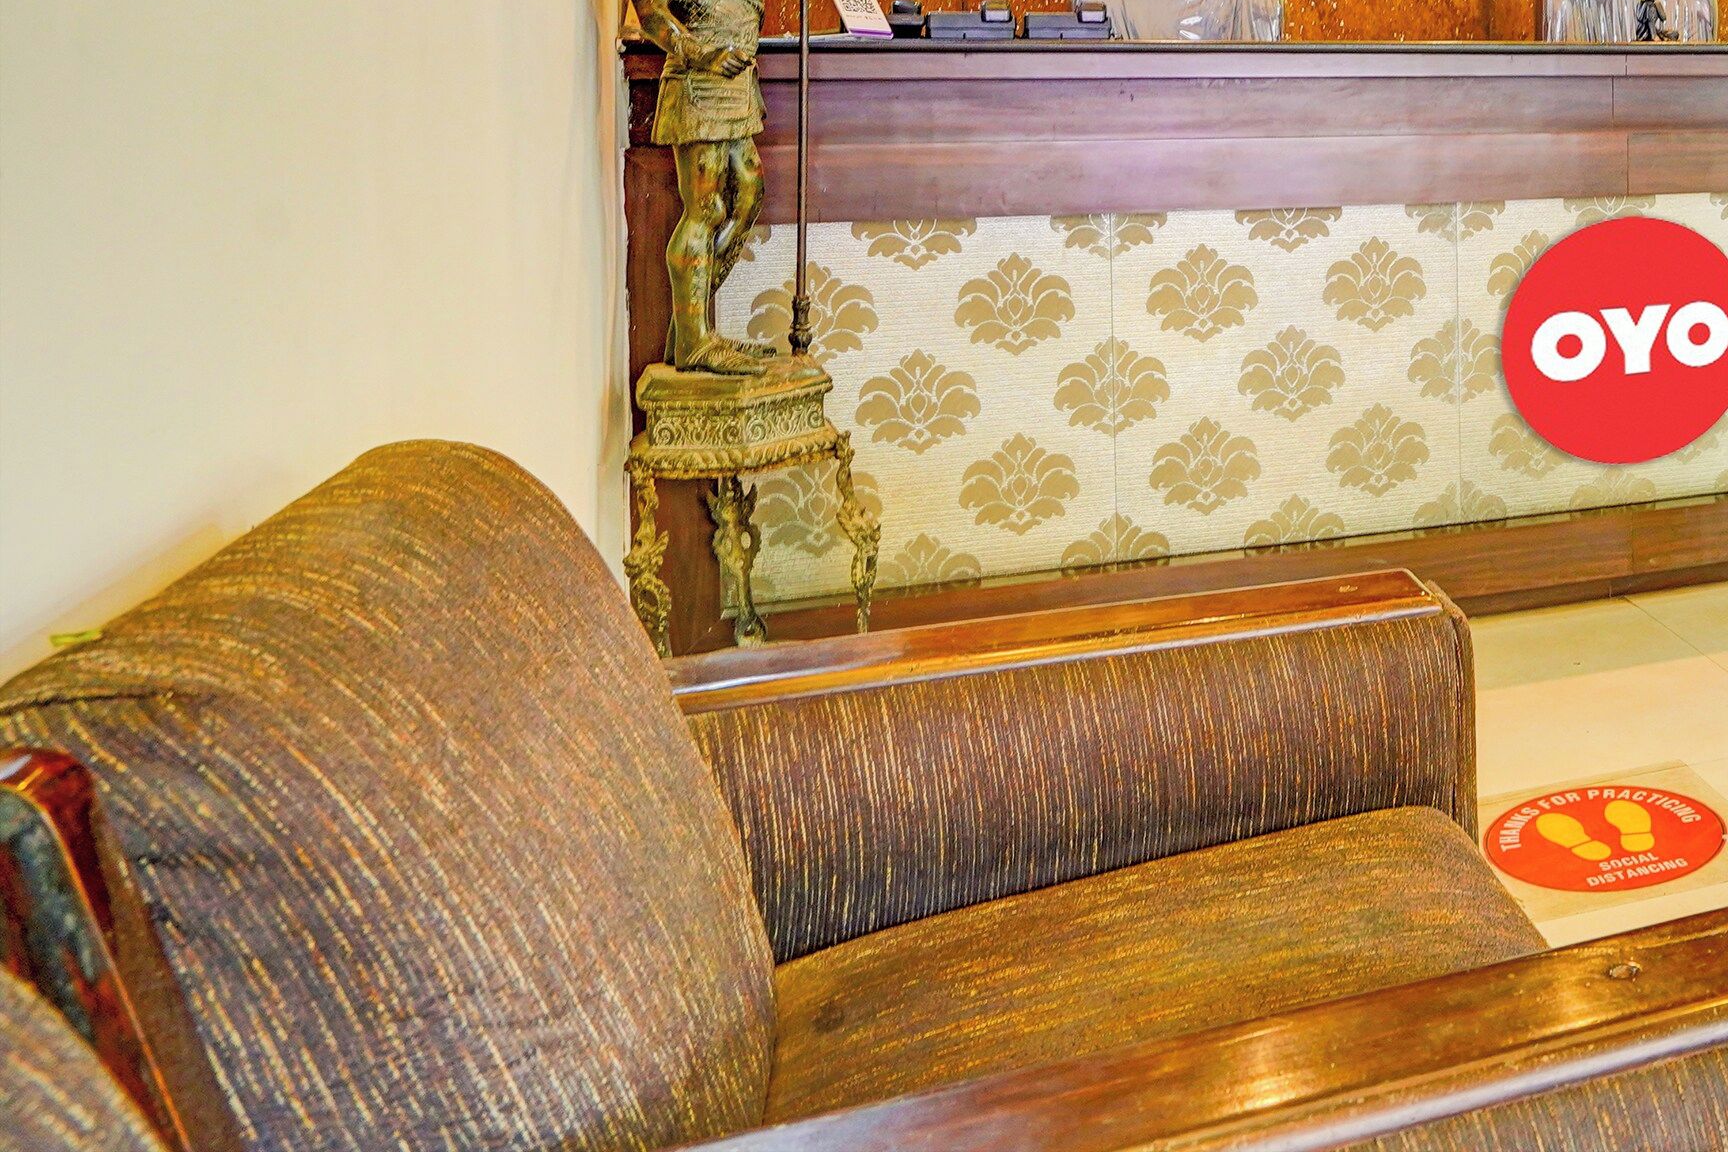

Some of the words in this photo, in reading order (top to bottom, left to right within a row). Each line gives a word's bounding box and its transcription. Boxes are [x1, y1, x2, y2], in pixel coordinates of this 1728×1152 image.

[1501, 806, 1540, 852] THANKS
[1540, 792, 1581, 810] FOR
[1587, 789, 1702, 824] PRACTICING
[1586, 857, 1688, 887] DISTANCING
[1599, 852, 1659, 872] SOCIAL
